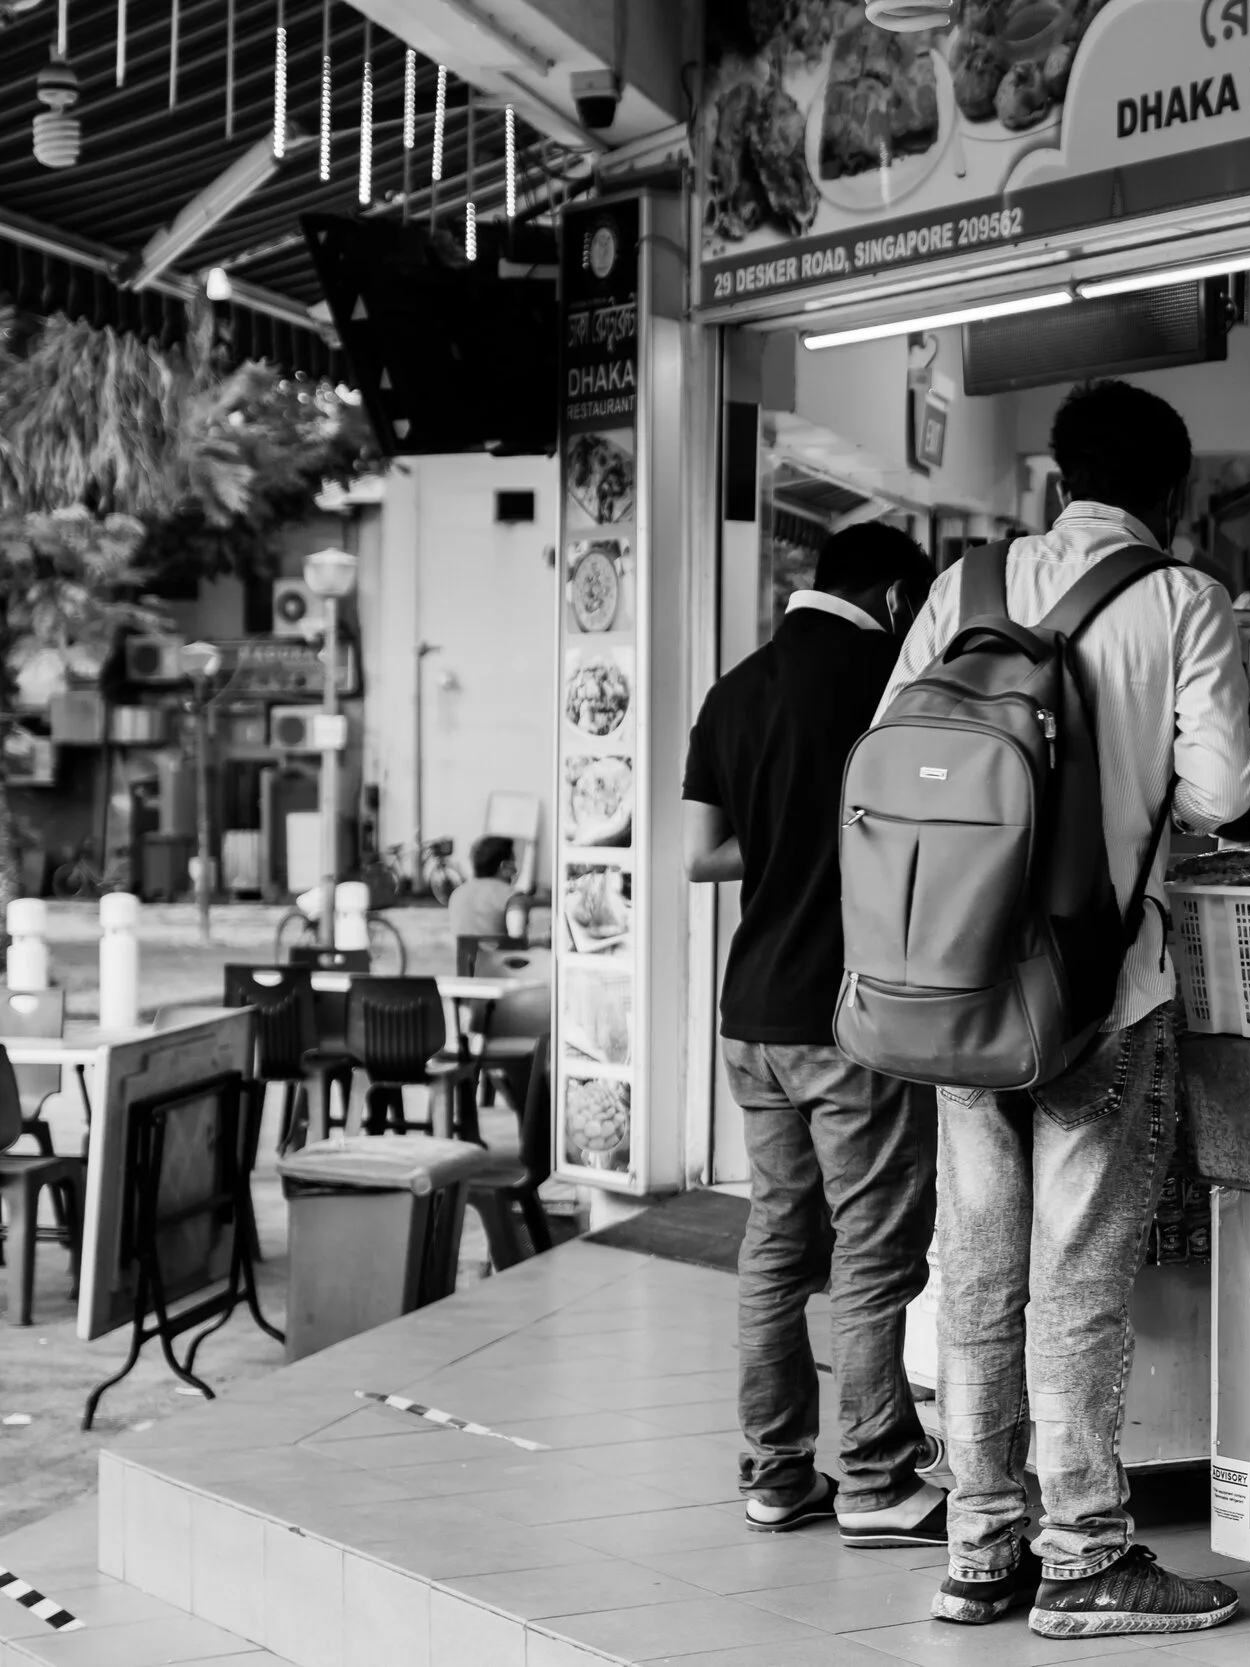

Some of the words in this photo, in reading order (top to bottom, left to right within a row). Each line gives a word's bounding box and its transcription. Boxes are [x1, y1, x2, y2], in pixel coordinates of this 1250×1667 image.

[1117, 74, 1239, 138] DHAKA
[714, 271, 731, 297] 29
[736, 257, 797, 292] DESKER
[802, 246, 849, 279] ROAD,
[855, 222, 953, 265] SINGAPORE
[958, 207, 1023, 243] 209562
[568, 360, 635, 398] DHAKA
[567, 394, 635, 420] RESTAURANT
[1212, 1468, 1247, 1484] ADVISORY
